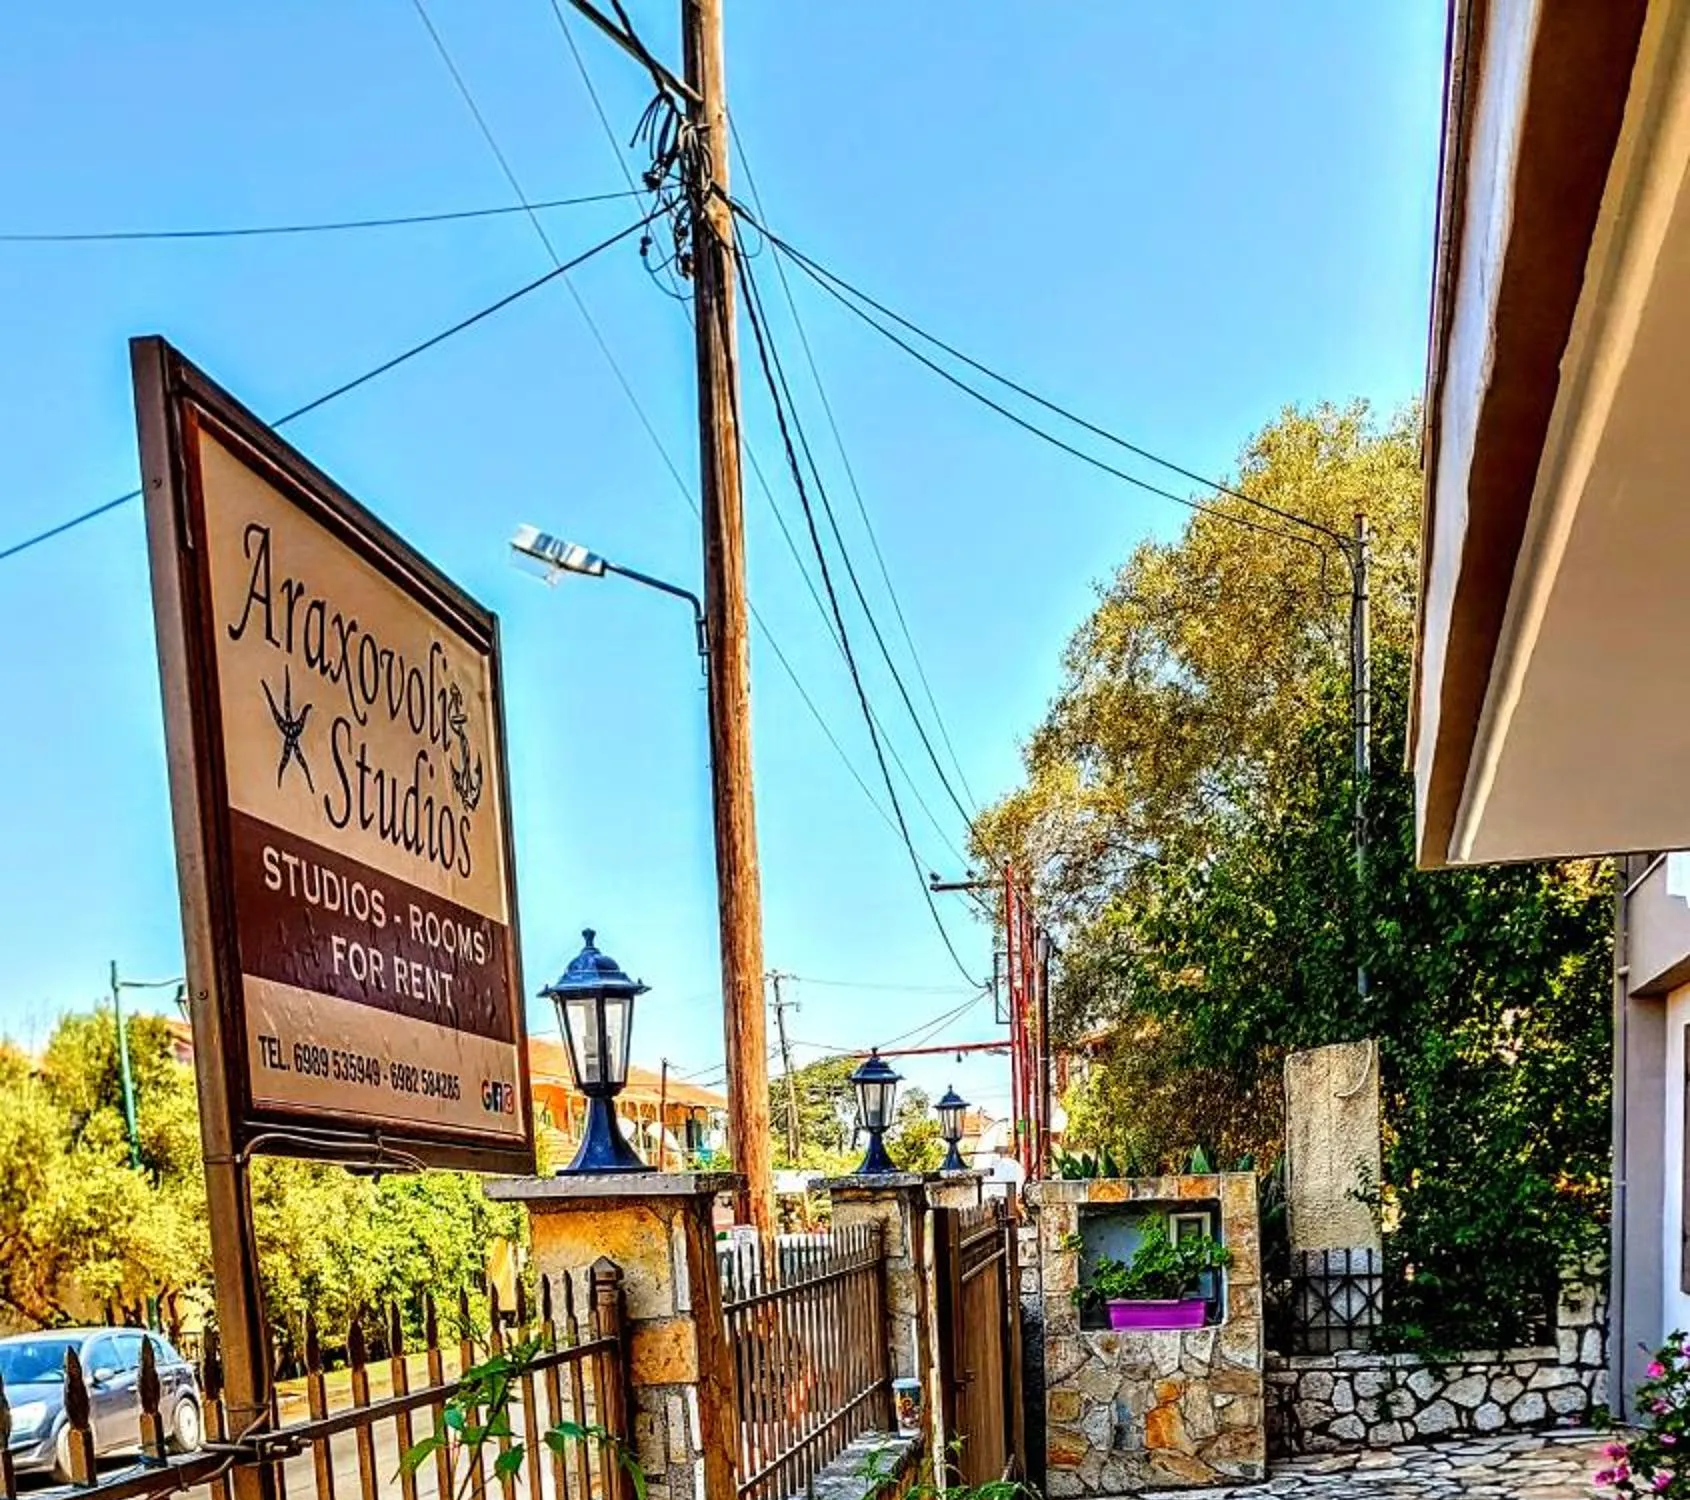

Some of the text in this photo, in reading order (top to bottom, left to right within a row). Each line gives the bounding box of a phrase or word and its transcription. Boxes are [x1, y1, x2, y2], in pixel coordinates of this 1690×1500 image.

[228, 522, 453, 753] Araxovoli
[324, 716, 472, 879] Studios
[263, 845, 387, 929] STUDIOS
[409, 903, 486, 966] ROOMS
[332, 935, 453, 1008] FOR RENT
[258, 1035, 291, 1071] TEL.
[293, 1042, 329, 1078] 6989
[333, 1049, 381, 1087] 535949
